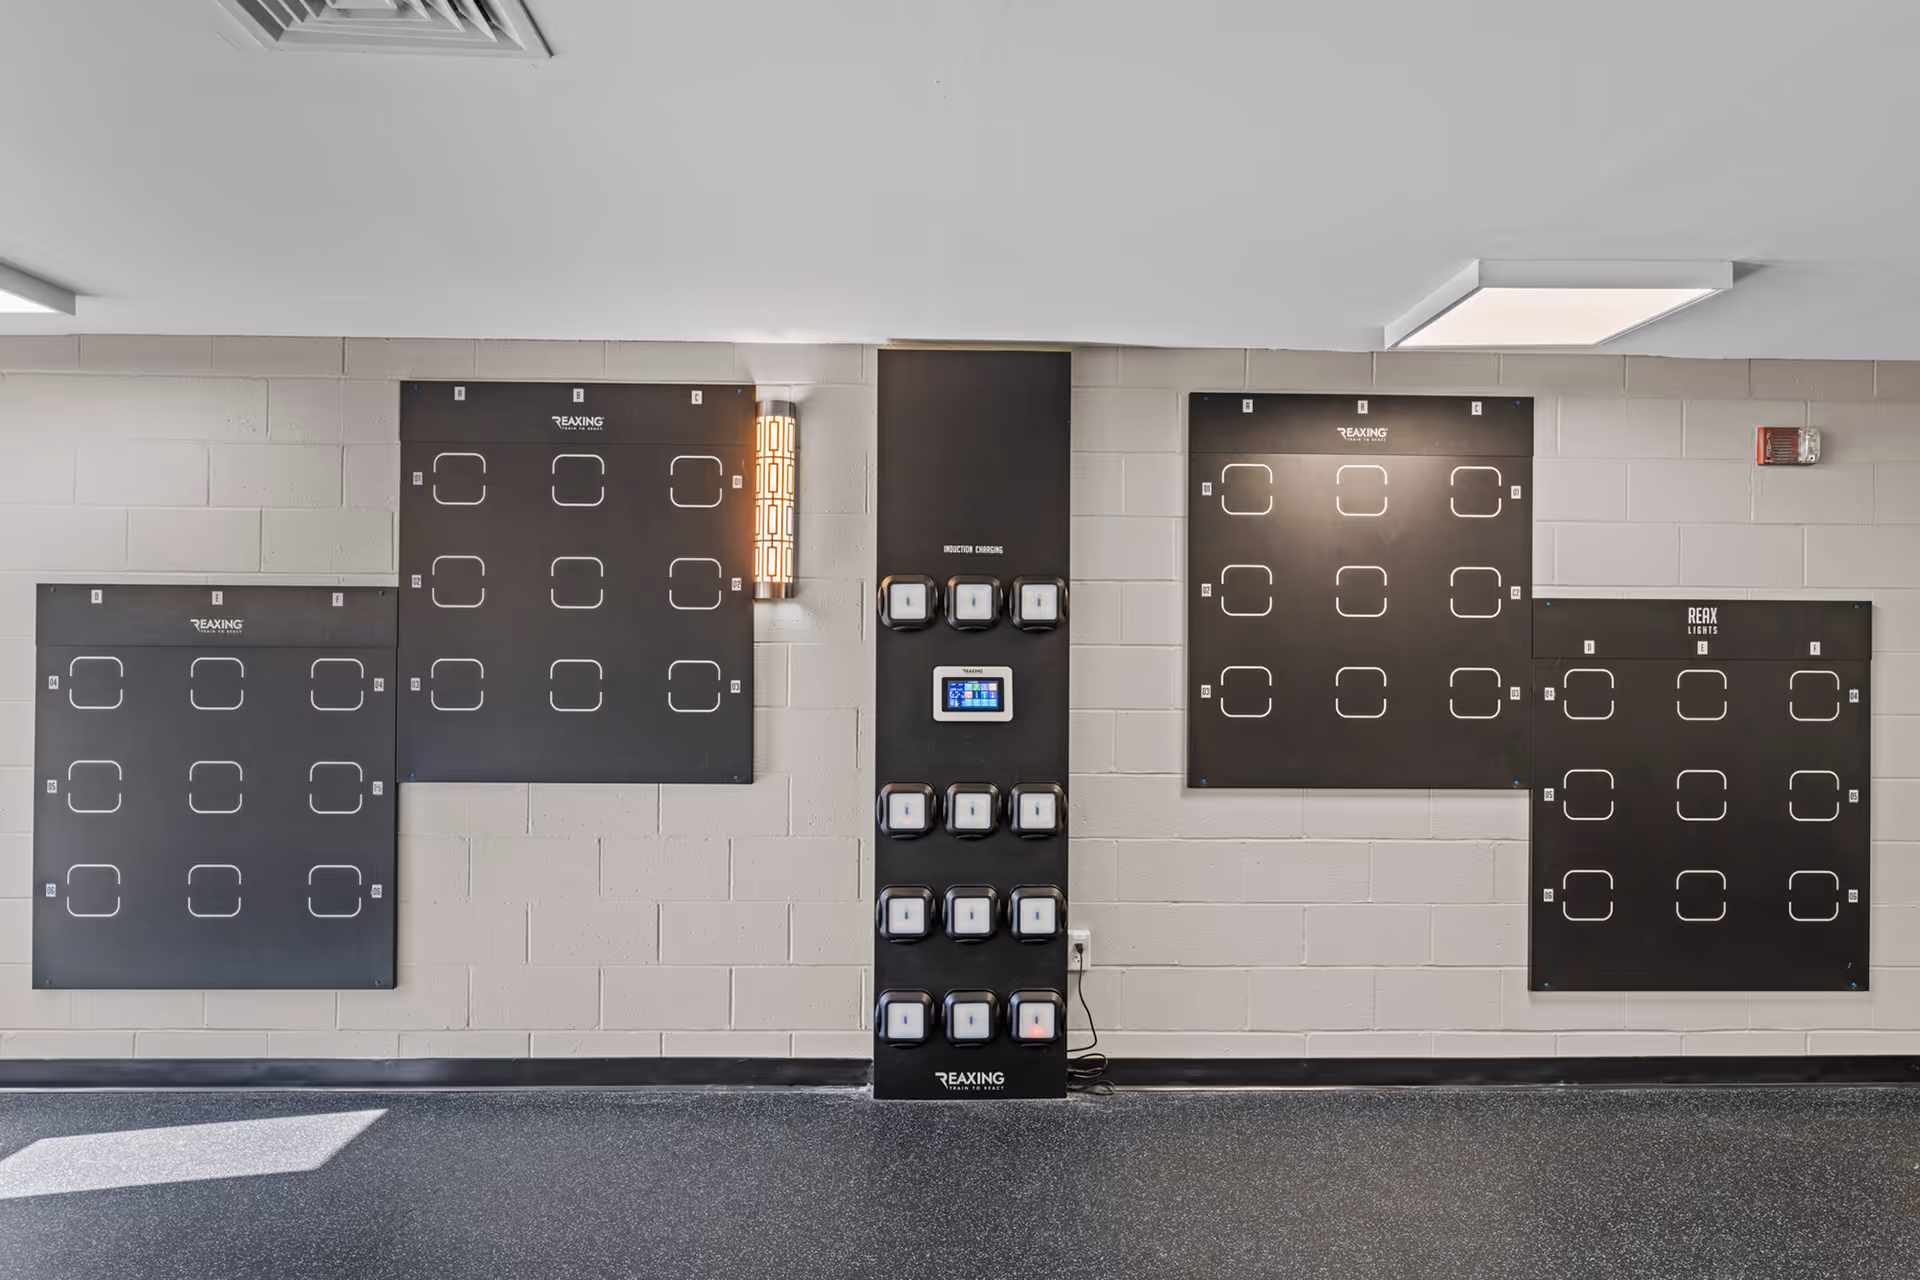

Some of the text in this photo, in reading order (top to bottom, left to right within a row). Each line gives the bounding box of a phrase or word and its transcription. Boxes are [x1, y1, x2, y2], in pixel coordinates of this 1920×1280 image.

[551, 415, 604, 430] REAXING
[1337, 427, 1388, 441] REAXING
[943, 545, 1004, 554] INDUCTION CHARGING
[1688, 606, 1718, 625] REAX
[190, 618, 243, 633] REAXING
[1687, 625, 1718, 635] LIGHTS
[934, 1071, 1005, 1090] REAXING
